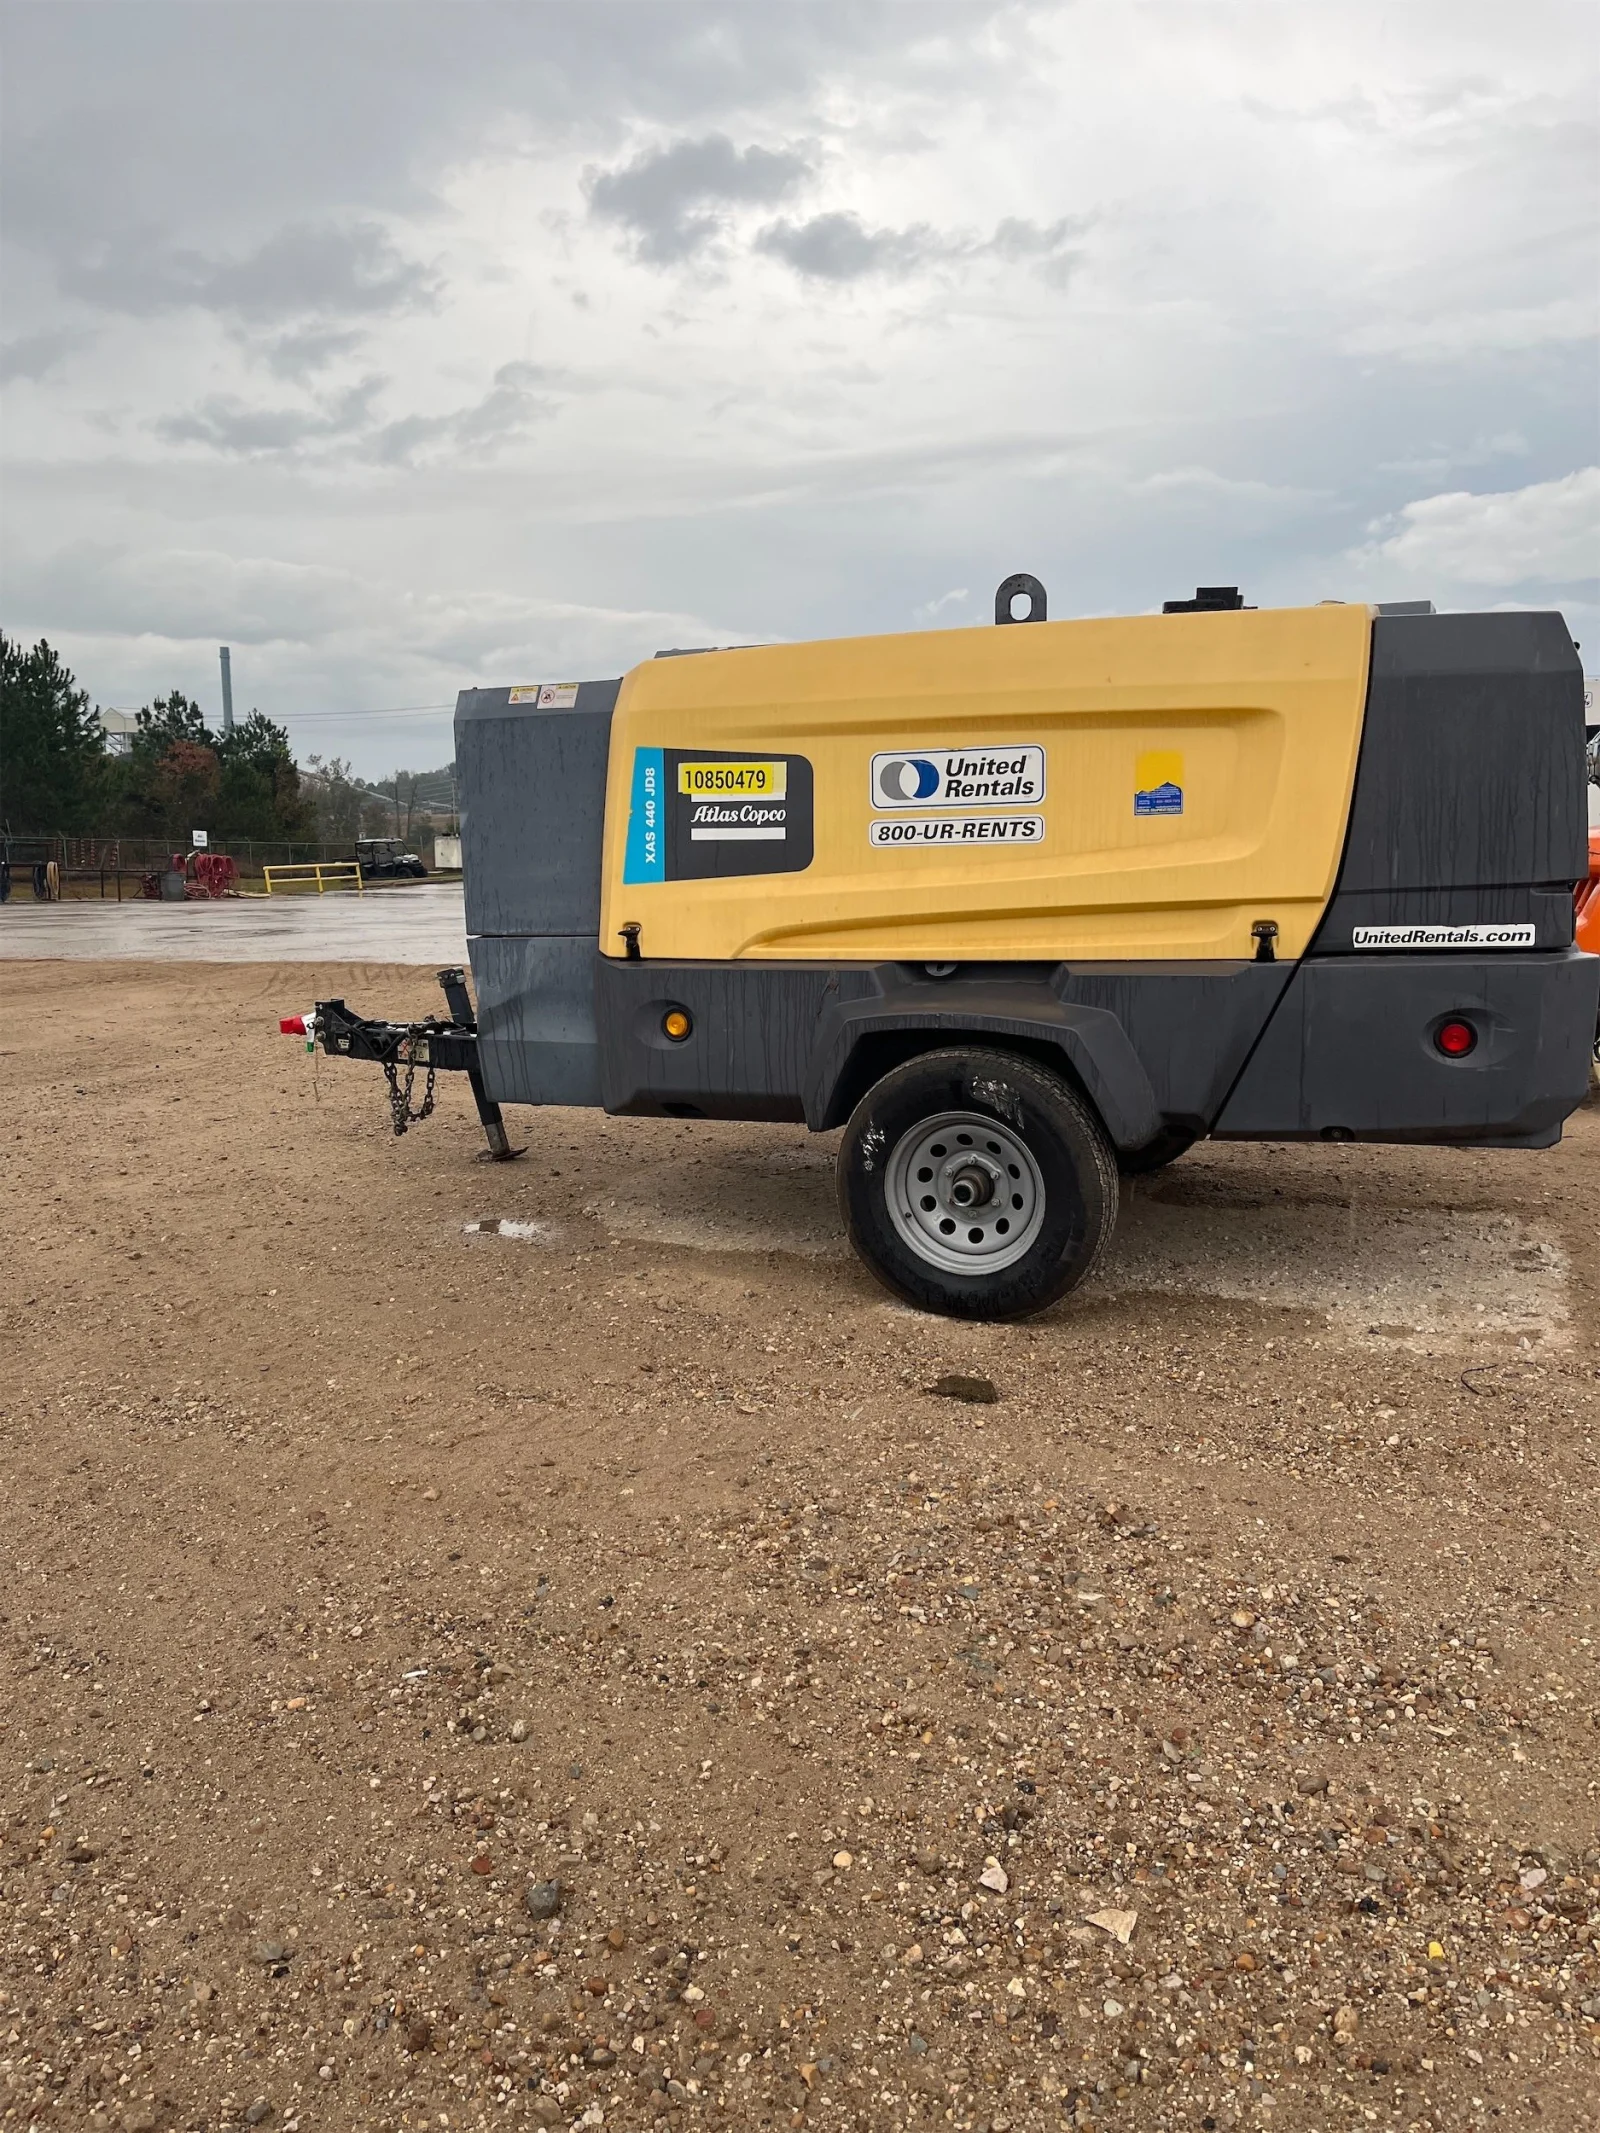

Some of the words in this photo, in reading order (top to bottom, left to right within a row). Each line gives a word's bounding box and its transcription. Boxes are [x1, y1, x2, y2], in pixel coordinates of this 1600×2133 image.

[945, 755, 1027, 777] United
[645, 767, 656, 796] JD8
[684, 770, 766, 789] 10850479
[945, 777, 1035, 798] Rentals
[645, 800, 656, 828] 440
[878, 820, 1036, 841] 800-UR-RENTS
[645, 831, 656, 863] XAS
[1354, 930, 1531, 944] UnitedRentals.com
